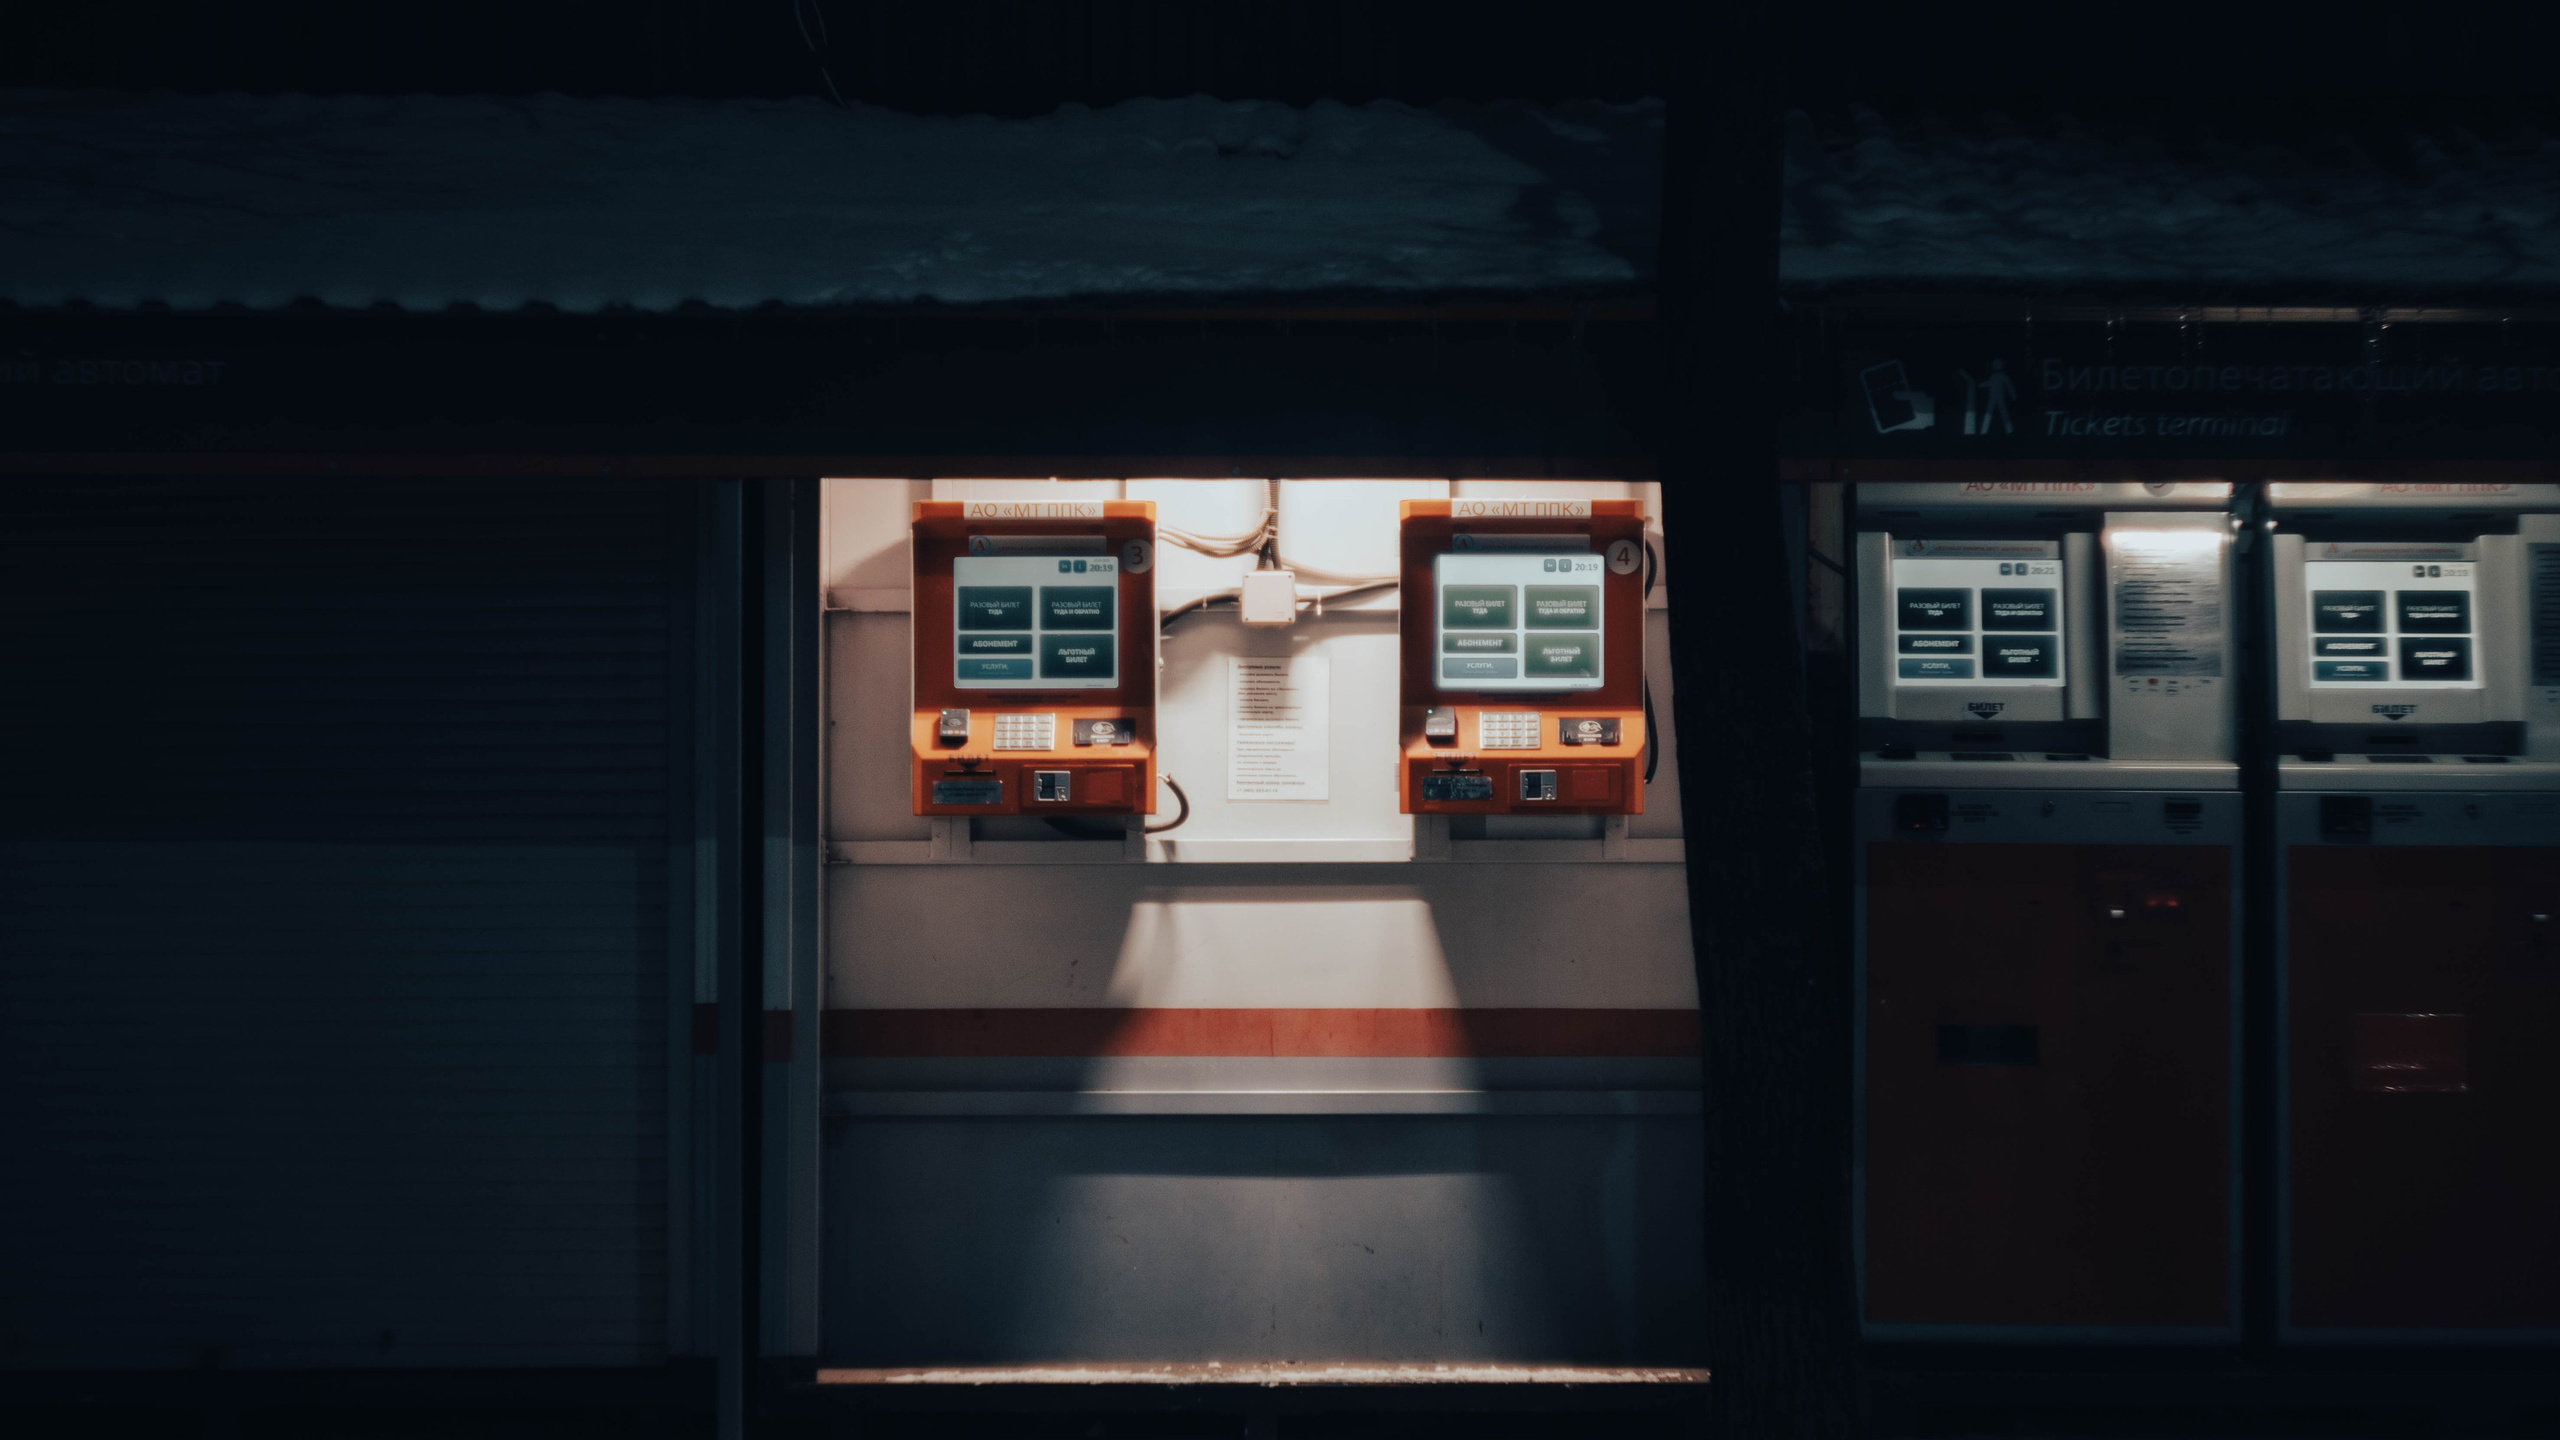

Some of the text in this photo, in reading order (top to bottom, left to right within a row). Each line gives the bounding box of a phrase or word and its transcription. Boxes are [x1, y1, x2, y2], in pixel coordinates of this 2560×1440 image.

[53, 359, 226, 385] автомат
[2042, 355, 2463, 396] Билетопечатающий
[2044, 410, 2290, 437] Tickets terminal
[970, 502, 1096, 518] АО «МТ ППК»
[1458, 501, 1584, 516] АО «МТ ППК»
[1131, 545, 1143, 566] 3
[1616, 547, 1631, 565] 4
[1089, 564, 1114, 572] 20:19
[1574, 563, 1599, 571] 20:19
[1058, 648, 1096, 656] ЛЬГОТНЫЙ
[1542, 647, 1581, 655] ЛЬГОТНЫЙ
[1968, 702, 2005, 711] БИЛЕТ
[2372, 704, 2417, 713] БИЛЕТ
